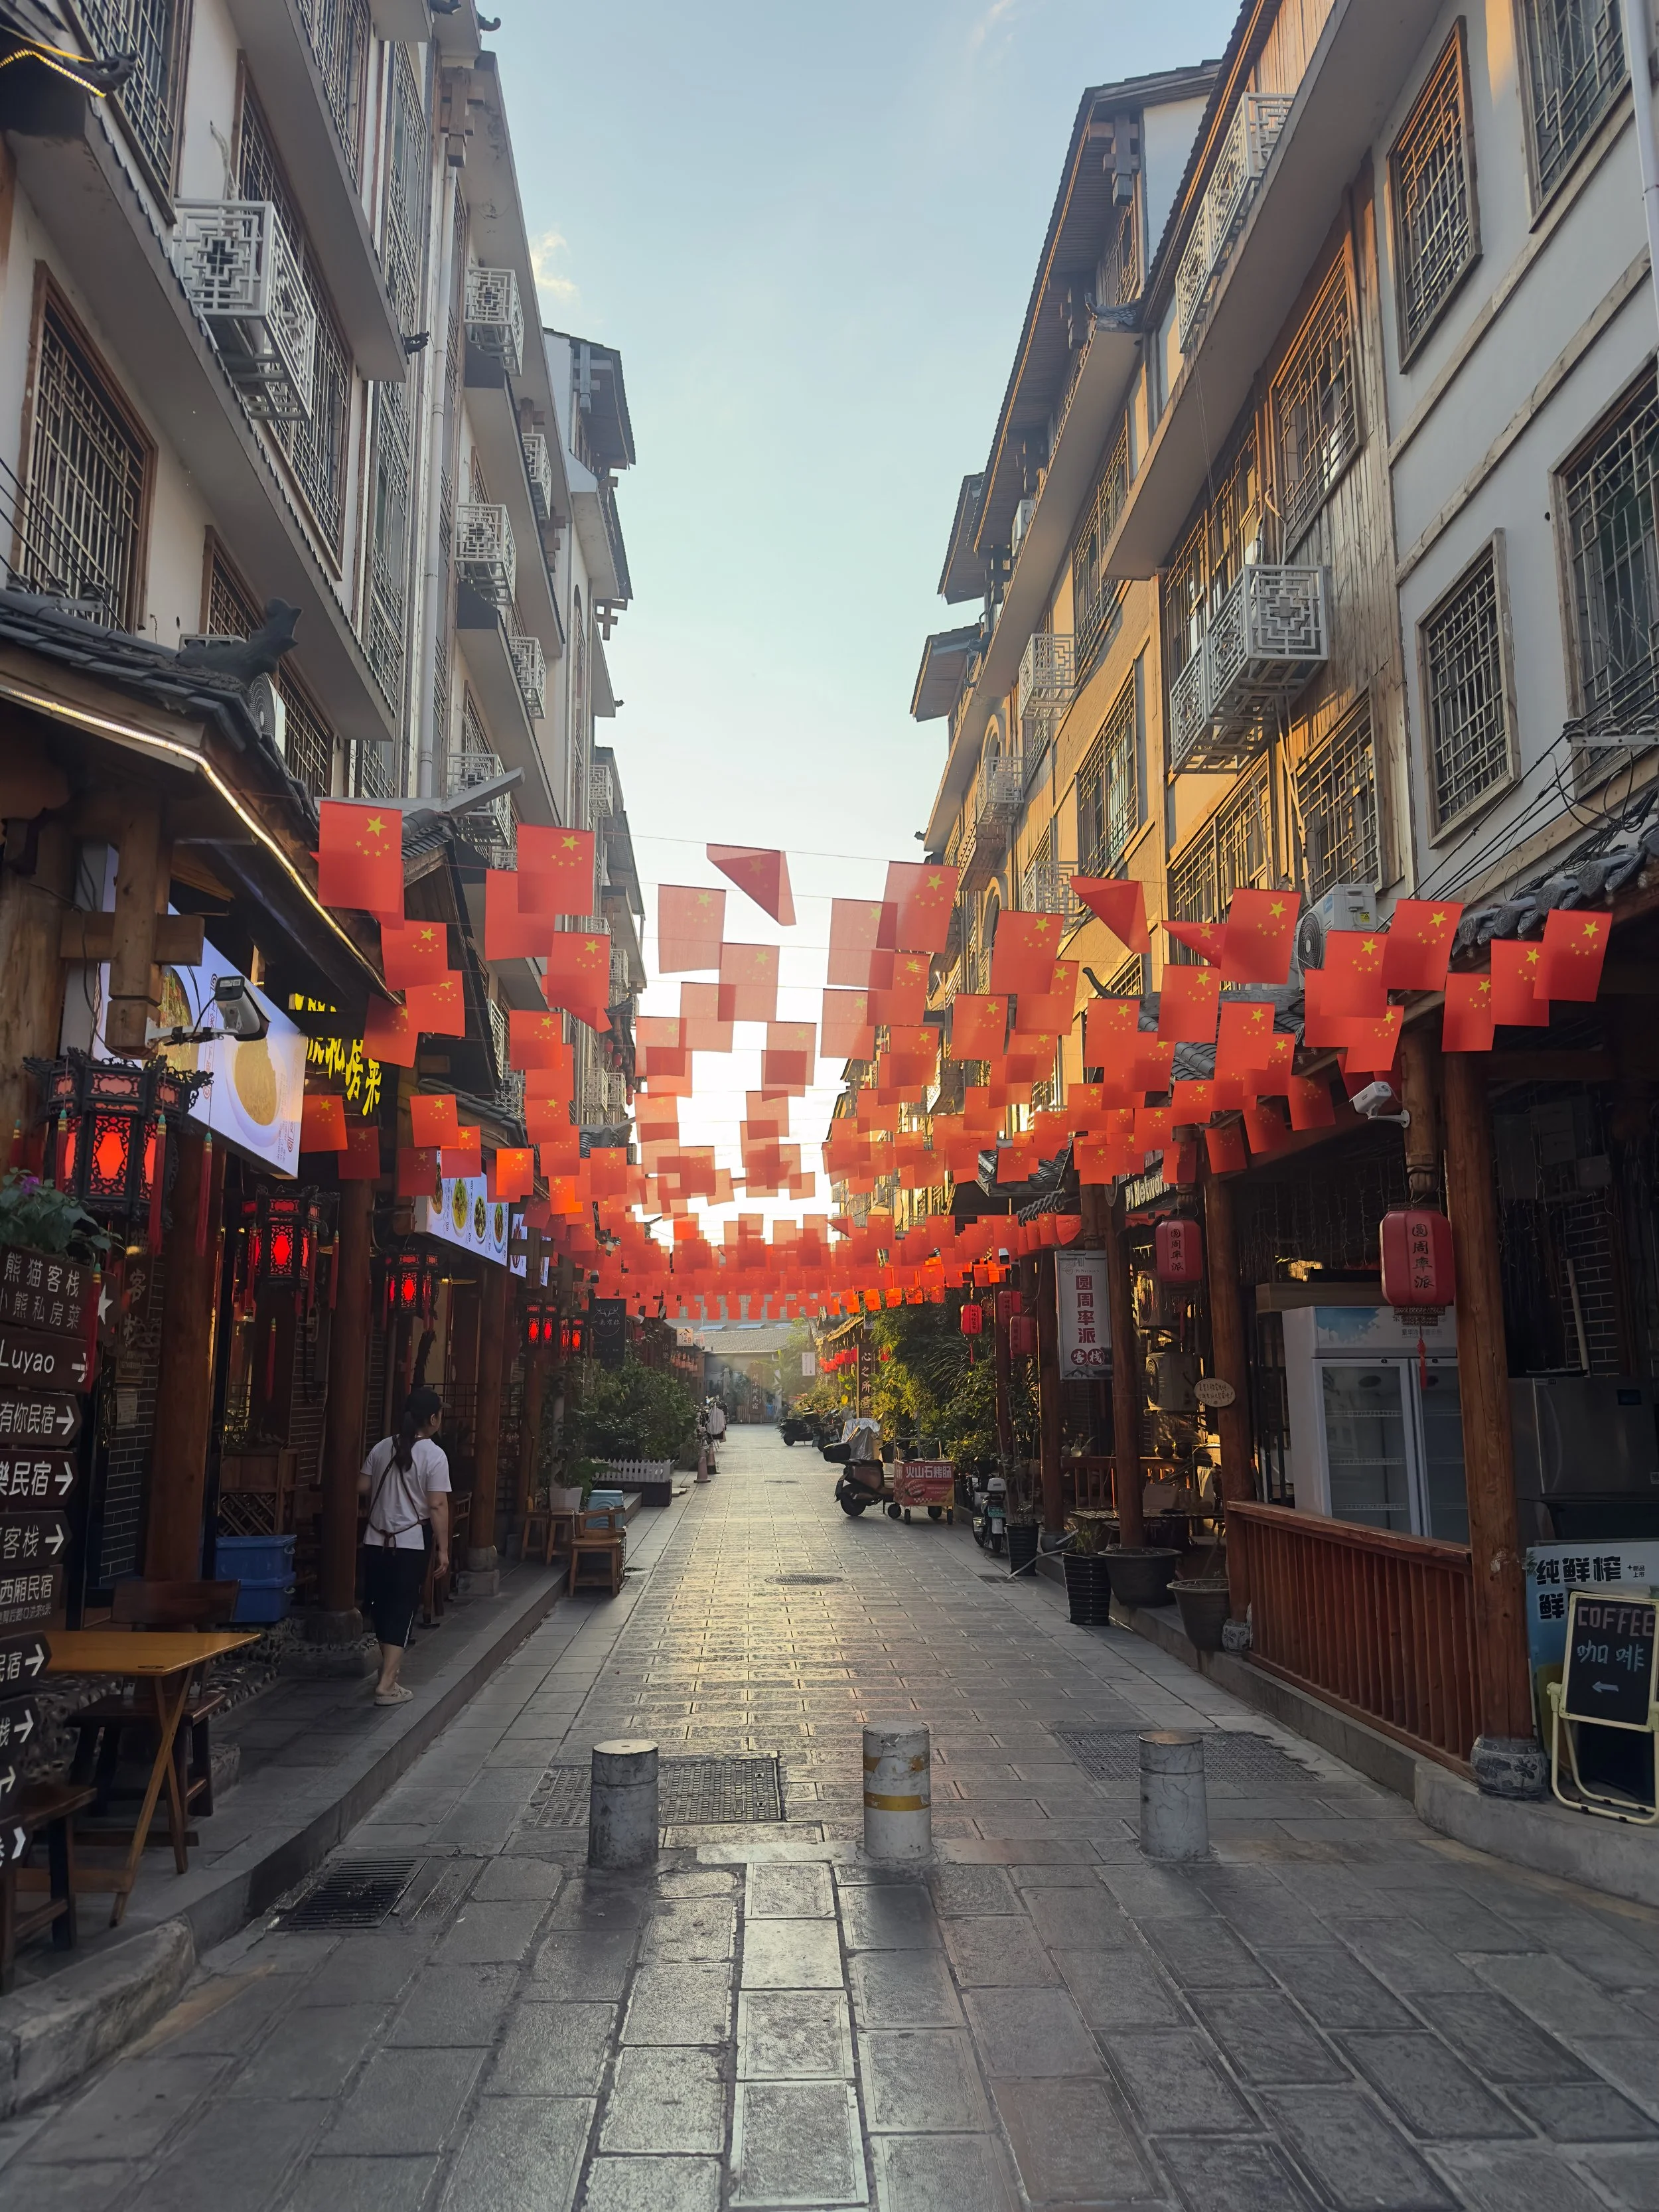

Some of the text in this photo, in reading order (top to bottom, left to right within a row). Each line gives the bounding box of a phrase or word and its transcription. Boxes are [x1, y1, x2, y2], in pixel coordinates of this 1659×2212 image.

[1171, 1228, 1184, 1271] 圆周率派
[1412, 1224, 1435, 1288] 圆周率派
[4, 1251, 80, 1297] 熊猫客栈
[0, 1287, 81, 1329] 小熊私房菜
[1075, 1276, 1096, 1343] 圆周率派
[0, 1339, 54, 1374] Luyao
[1072, 1350, 1104, 1364] 客栈
[0, 1402, 56, 1434] 有你民宿
[906, 1465, 952, 1479] 火山石烤肠
[0, 1525, 39, 1558] 客栈
[1536, 1556, 1621, 1585] 纯鲜榨
[0, 1574, 53, 1605] 西厢民宿
[1577, 1606, 1656, 1637] COFFEE
[1577, 1639, 1645, 1672] 咖啡
